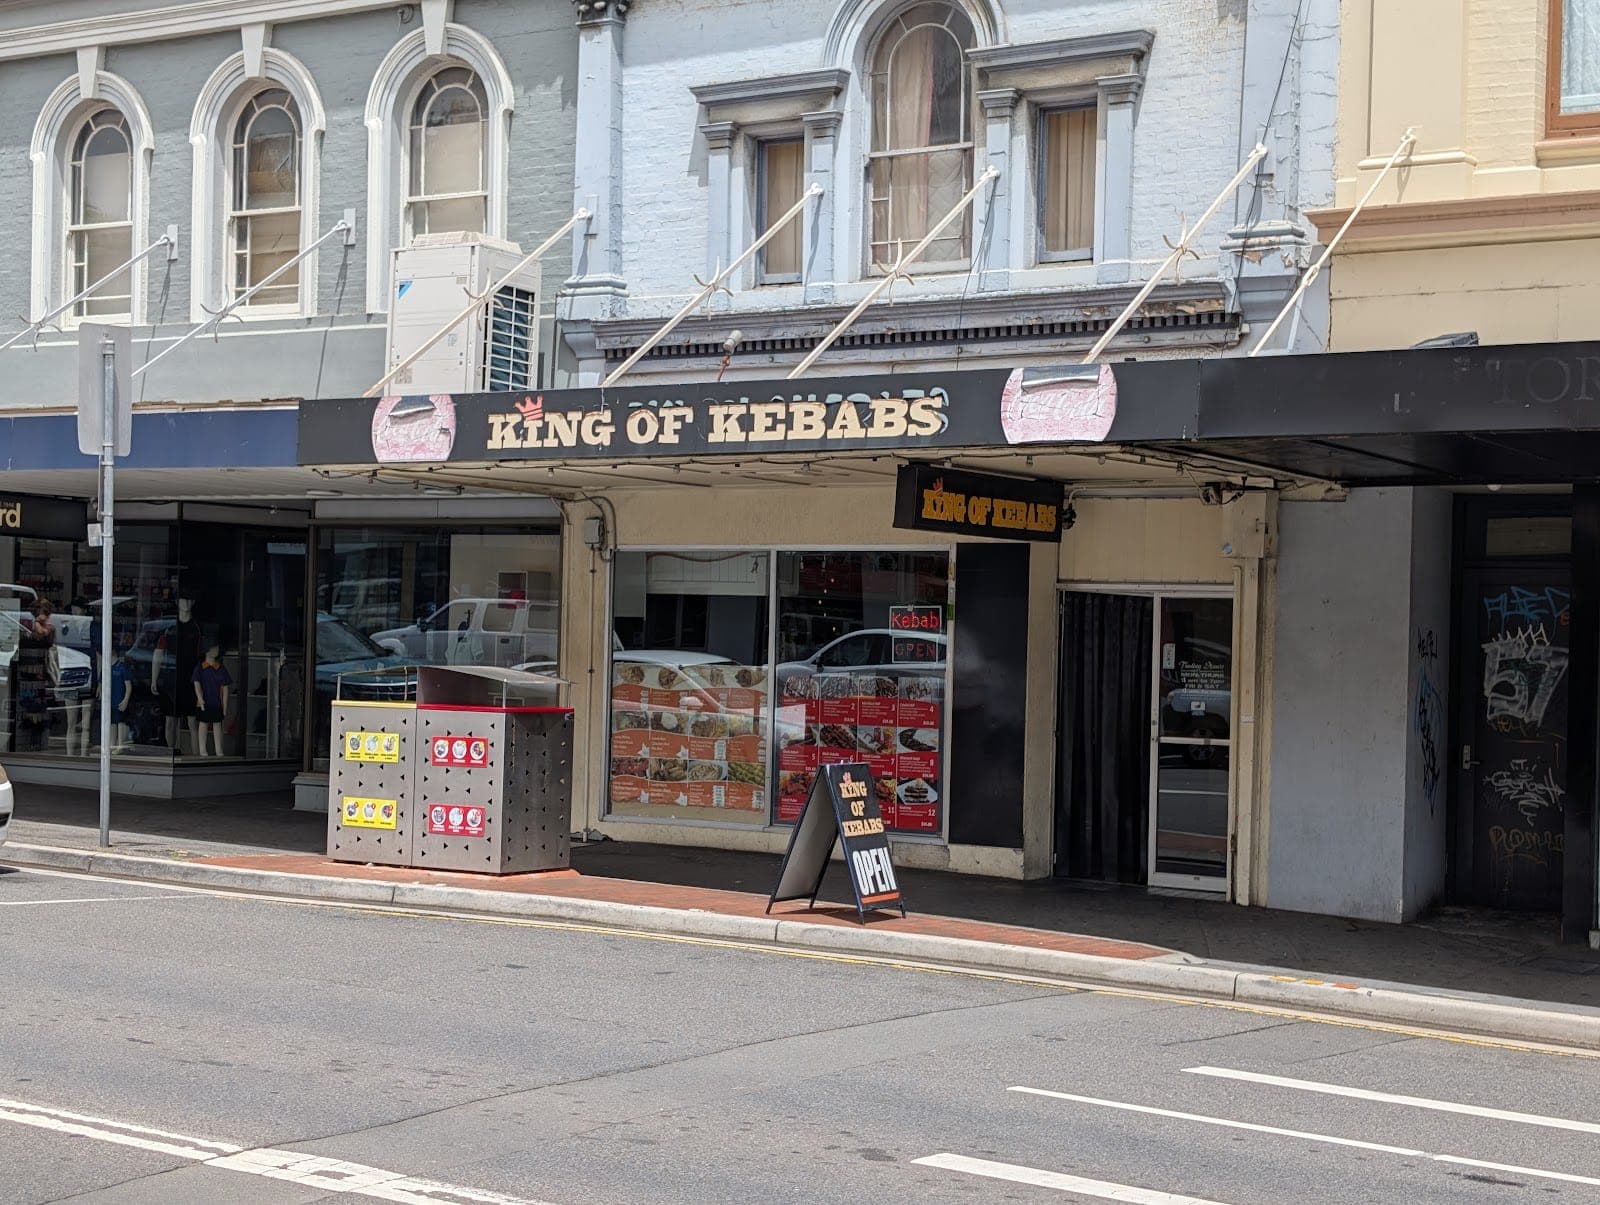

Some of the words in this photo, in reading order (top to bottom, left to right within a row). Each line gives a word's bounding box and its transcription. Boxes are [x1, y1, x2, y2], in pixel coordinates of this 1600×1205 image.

[487, 408, 616, 450] KING
[627, 407, 694, 445] OF
[707, 396, 944, 442] KEBABS
[921, 488, 967, 523] KING
[967, 495, 992, 526] OF
[991, 498, 1058, 533] KEBABS
[891, 610, 940, 629] Kebab
[895, 643, 936, 658] OPEN
[839, 780, 868, 799] KING
[850, 800, 866, 817] OF
[842, 818, 885, 838] KEBABS
[852, 846, 898, 896] OPEN
